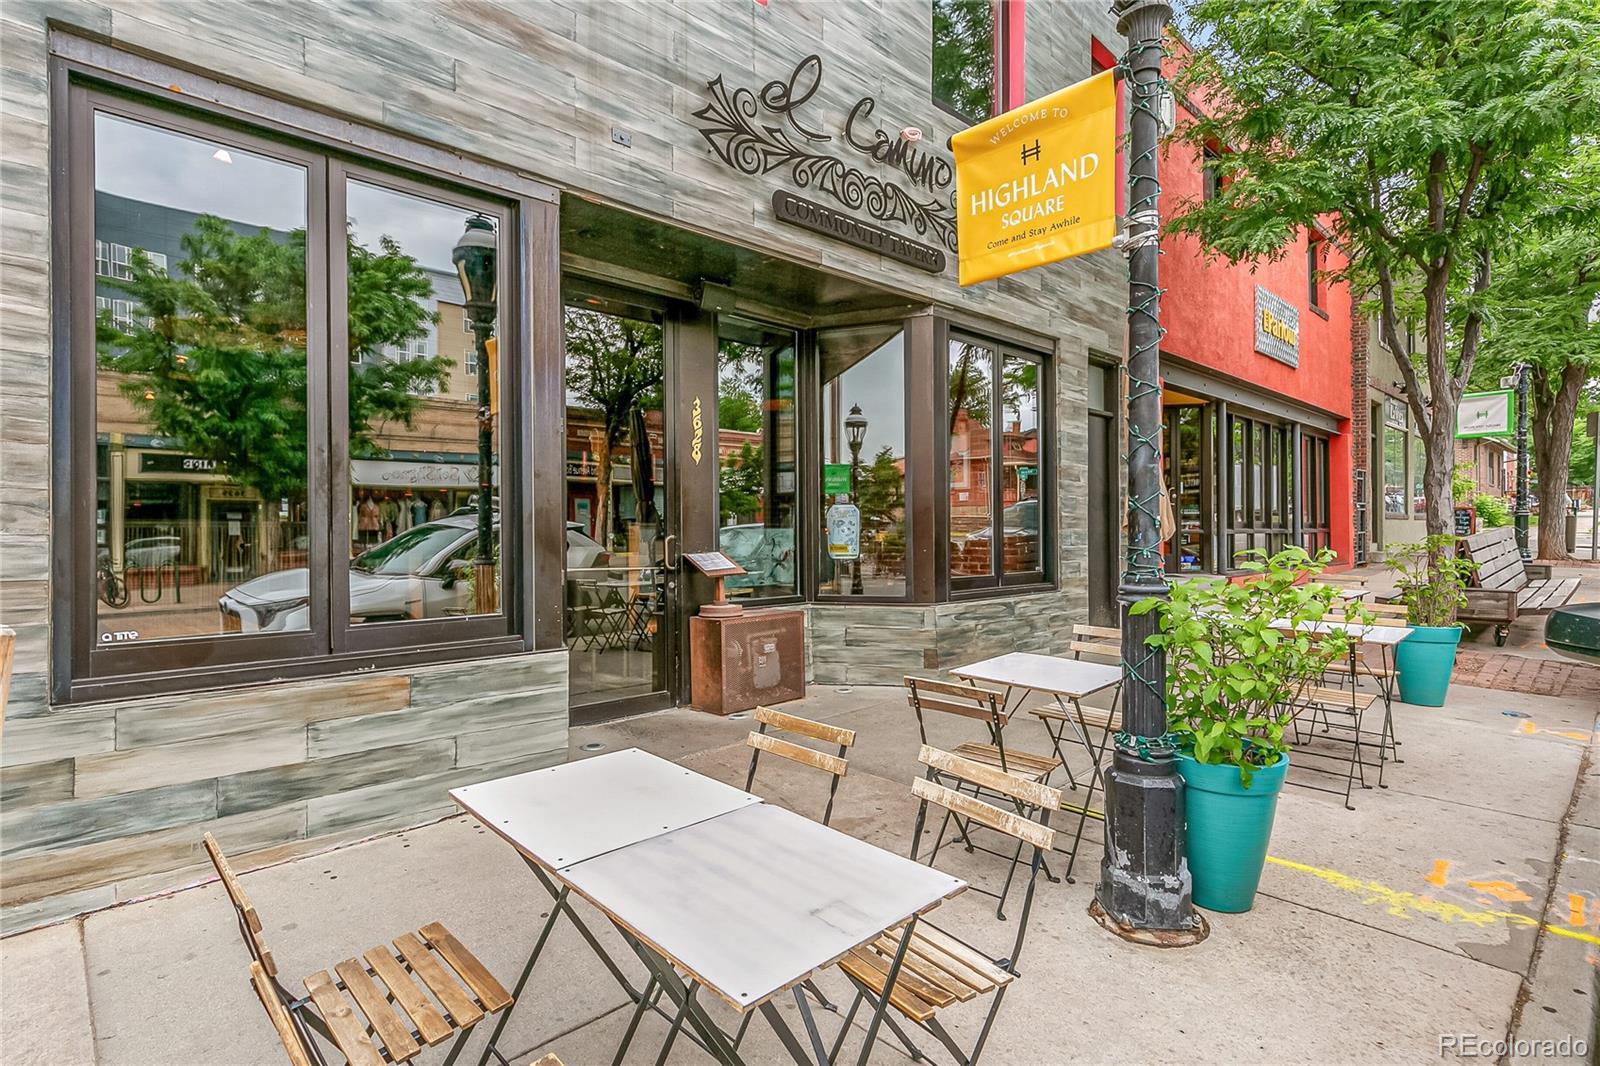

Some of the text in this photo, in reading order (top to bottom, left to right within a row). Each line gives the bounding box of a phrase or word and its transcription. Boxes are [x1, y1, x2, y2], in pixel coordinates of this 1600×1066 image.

[842, 96, 952, 193] Camino
[990, 106, 1070, 146] WELCOME TO
[970, 152, 1100, 216] HIGHLAND
[784, 197, 939, 267] COMMUNITY TAVERN
[986, 216, 1081, 250] Come and Stay Awhile
[1001, 195, 1065, 229] SQUARE
